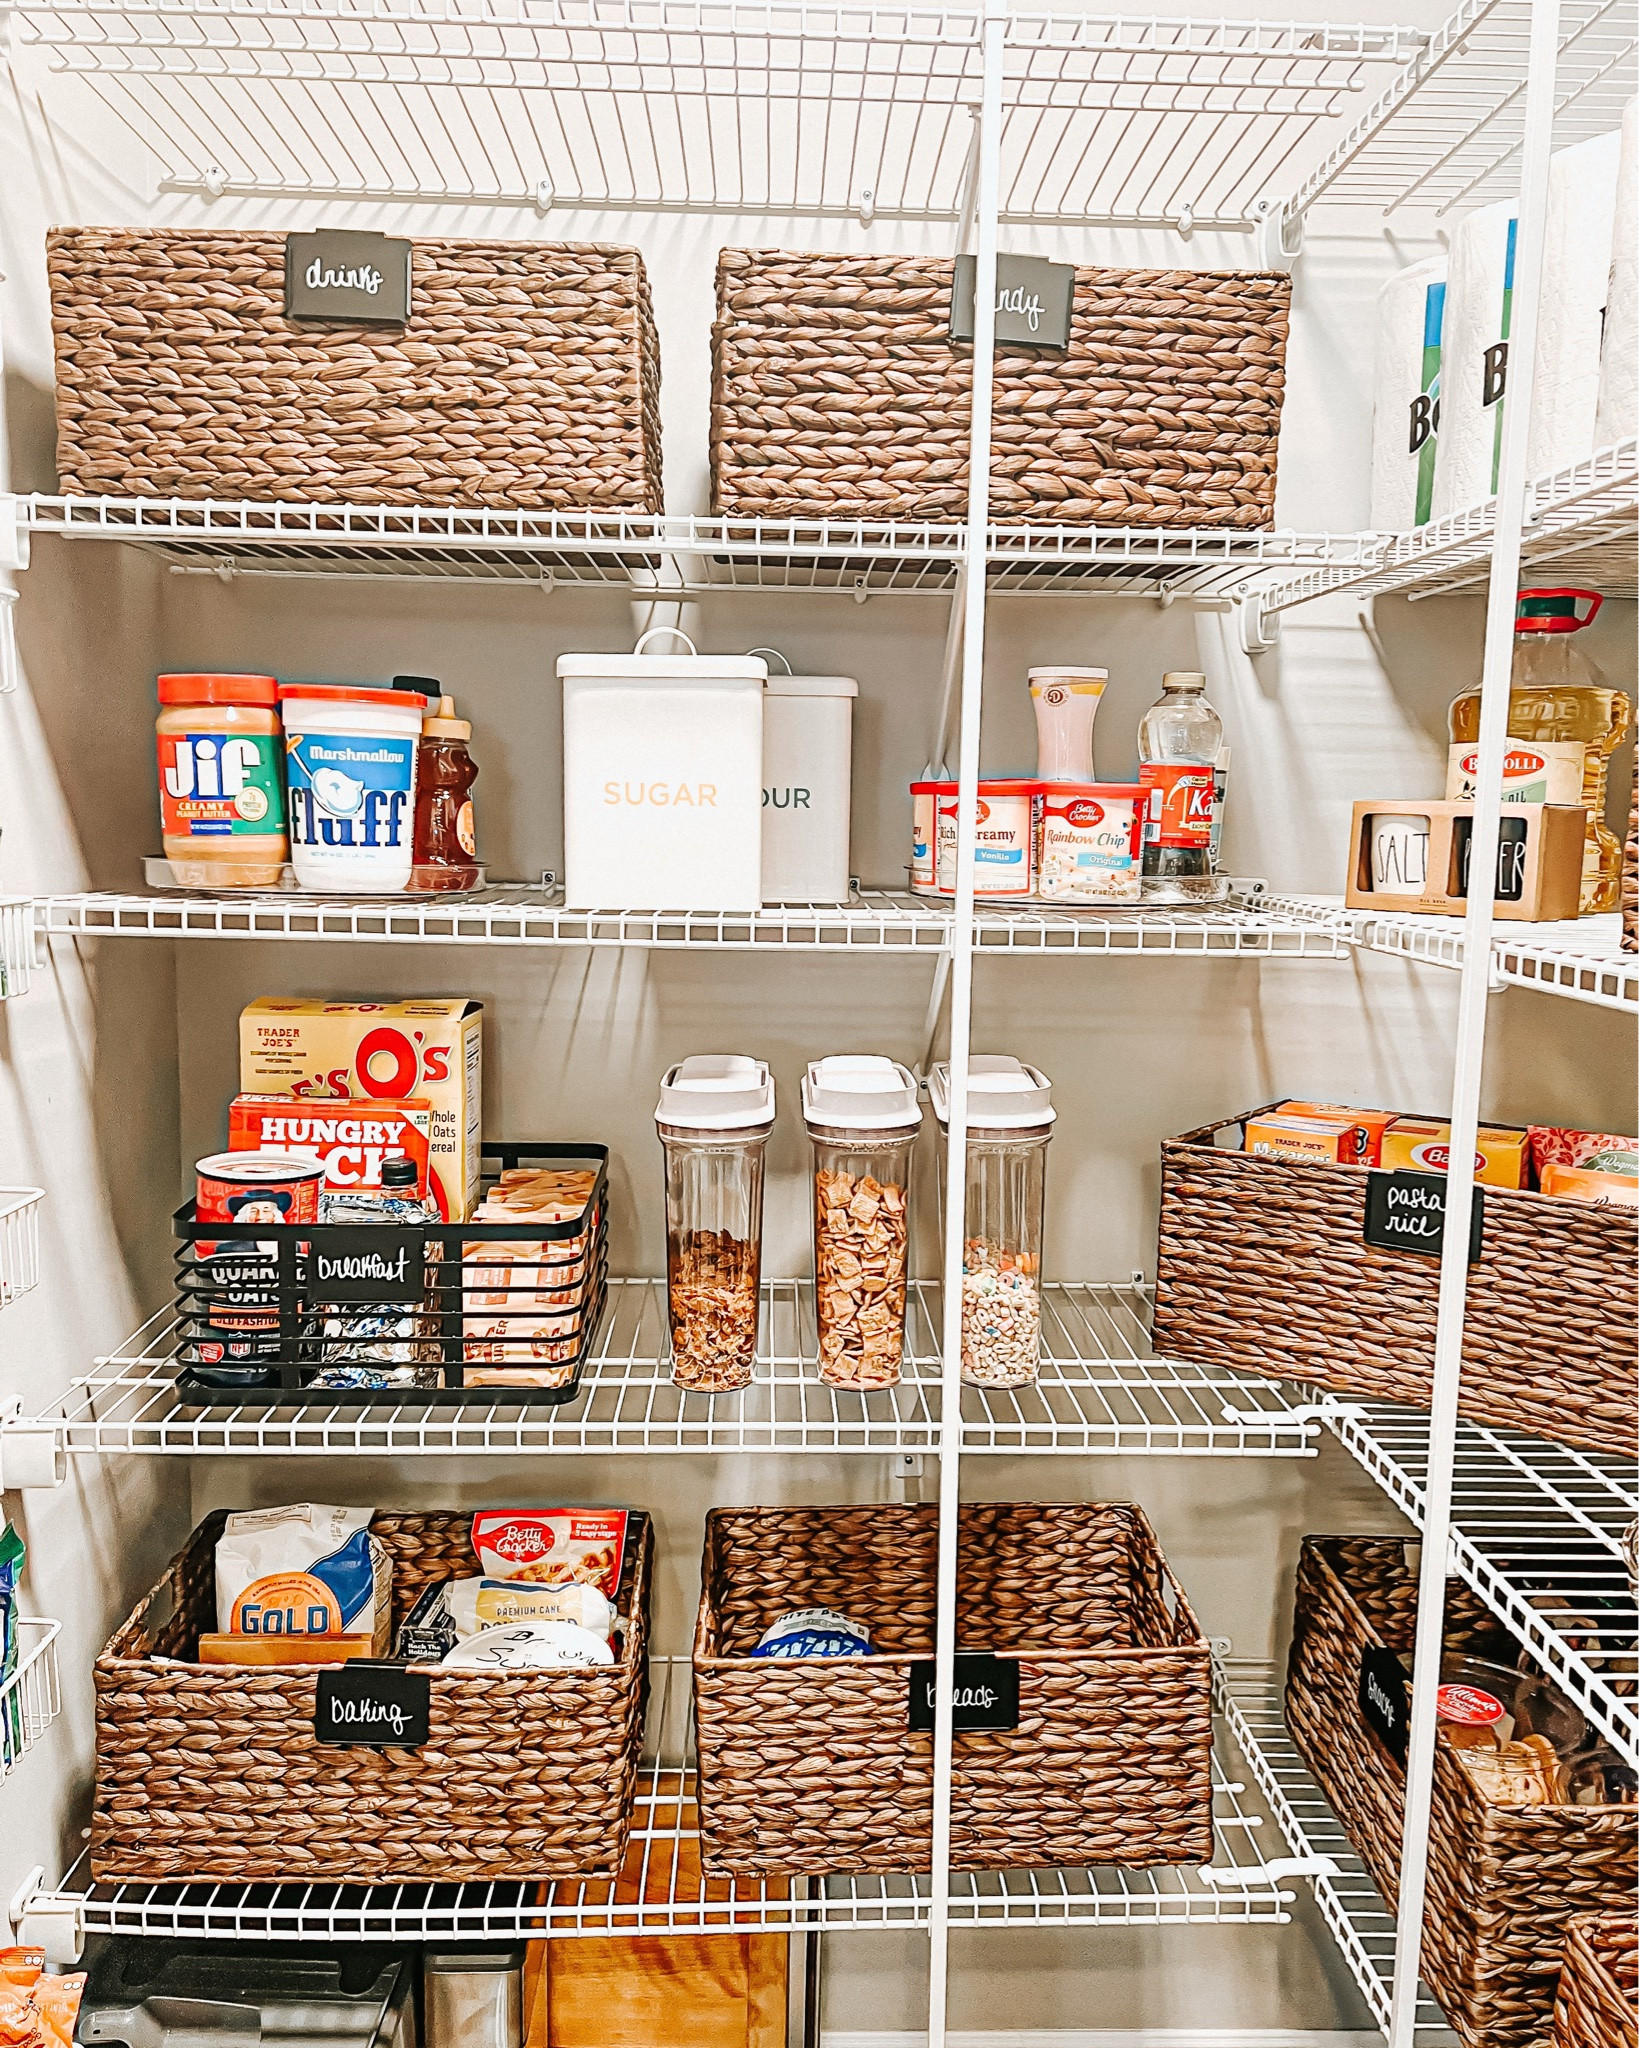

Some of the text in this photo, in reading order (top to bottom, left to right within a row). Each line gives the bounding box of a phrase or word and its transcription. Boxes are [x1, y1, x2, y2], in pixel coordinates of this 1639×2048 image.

[305, 257, 384, 295] drinks
[993, 286, 1046, 332] ndy
[309, 745, 404, 763] Marshmallow
[603, 781, 718, 807] SUGAR
[178, 802, 225, 811] CREAMY
[1075, 803, 1097, 816] Betty
[176, 810, 231, 818] PEANUT BUTTER
[291, 787, 407, 847] fluff
[1069, 811, 1101, 822] Crocker
[976, 830, 1016, 843] reamy
[1047, 829, 1125, 849] Rainbow Chip
[980, 850, 1010, 861] Vanilla
[1089, 855, 1122, 867] Original
[1377, 833, 1430, 884] SALT
[257, 1028, 300, 1038] TRADER
[261, 1039, 293, 1047] JOE'S
[260, 1117, 407, 1145] HUNGRY
[433, 1125, 456, 1138] Oats
[430, 1141, 456, 1153] ereal
[1274, 1138, 1301, 1147] TRADER
[1387, 1187, 1447, 1212] pasta
[1384, 1213, 1441, 1237] rice
[318, 1246, 411, 1284] breakfast
[231, 1343, 247, 1353] NFL
[576, 1522, 599, 1531] Ready
[504, 1525, 543, 1544] Betty
[497, 1605, 561, 1616] PREMIUM CANE
[779, 1610, 815, 1622] HITE
[241, 1604, 329, 1634] GOLD
[926, 1682, 999, 1708] beads
[331, 1695, 414, 1736] baking
